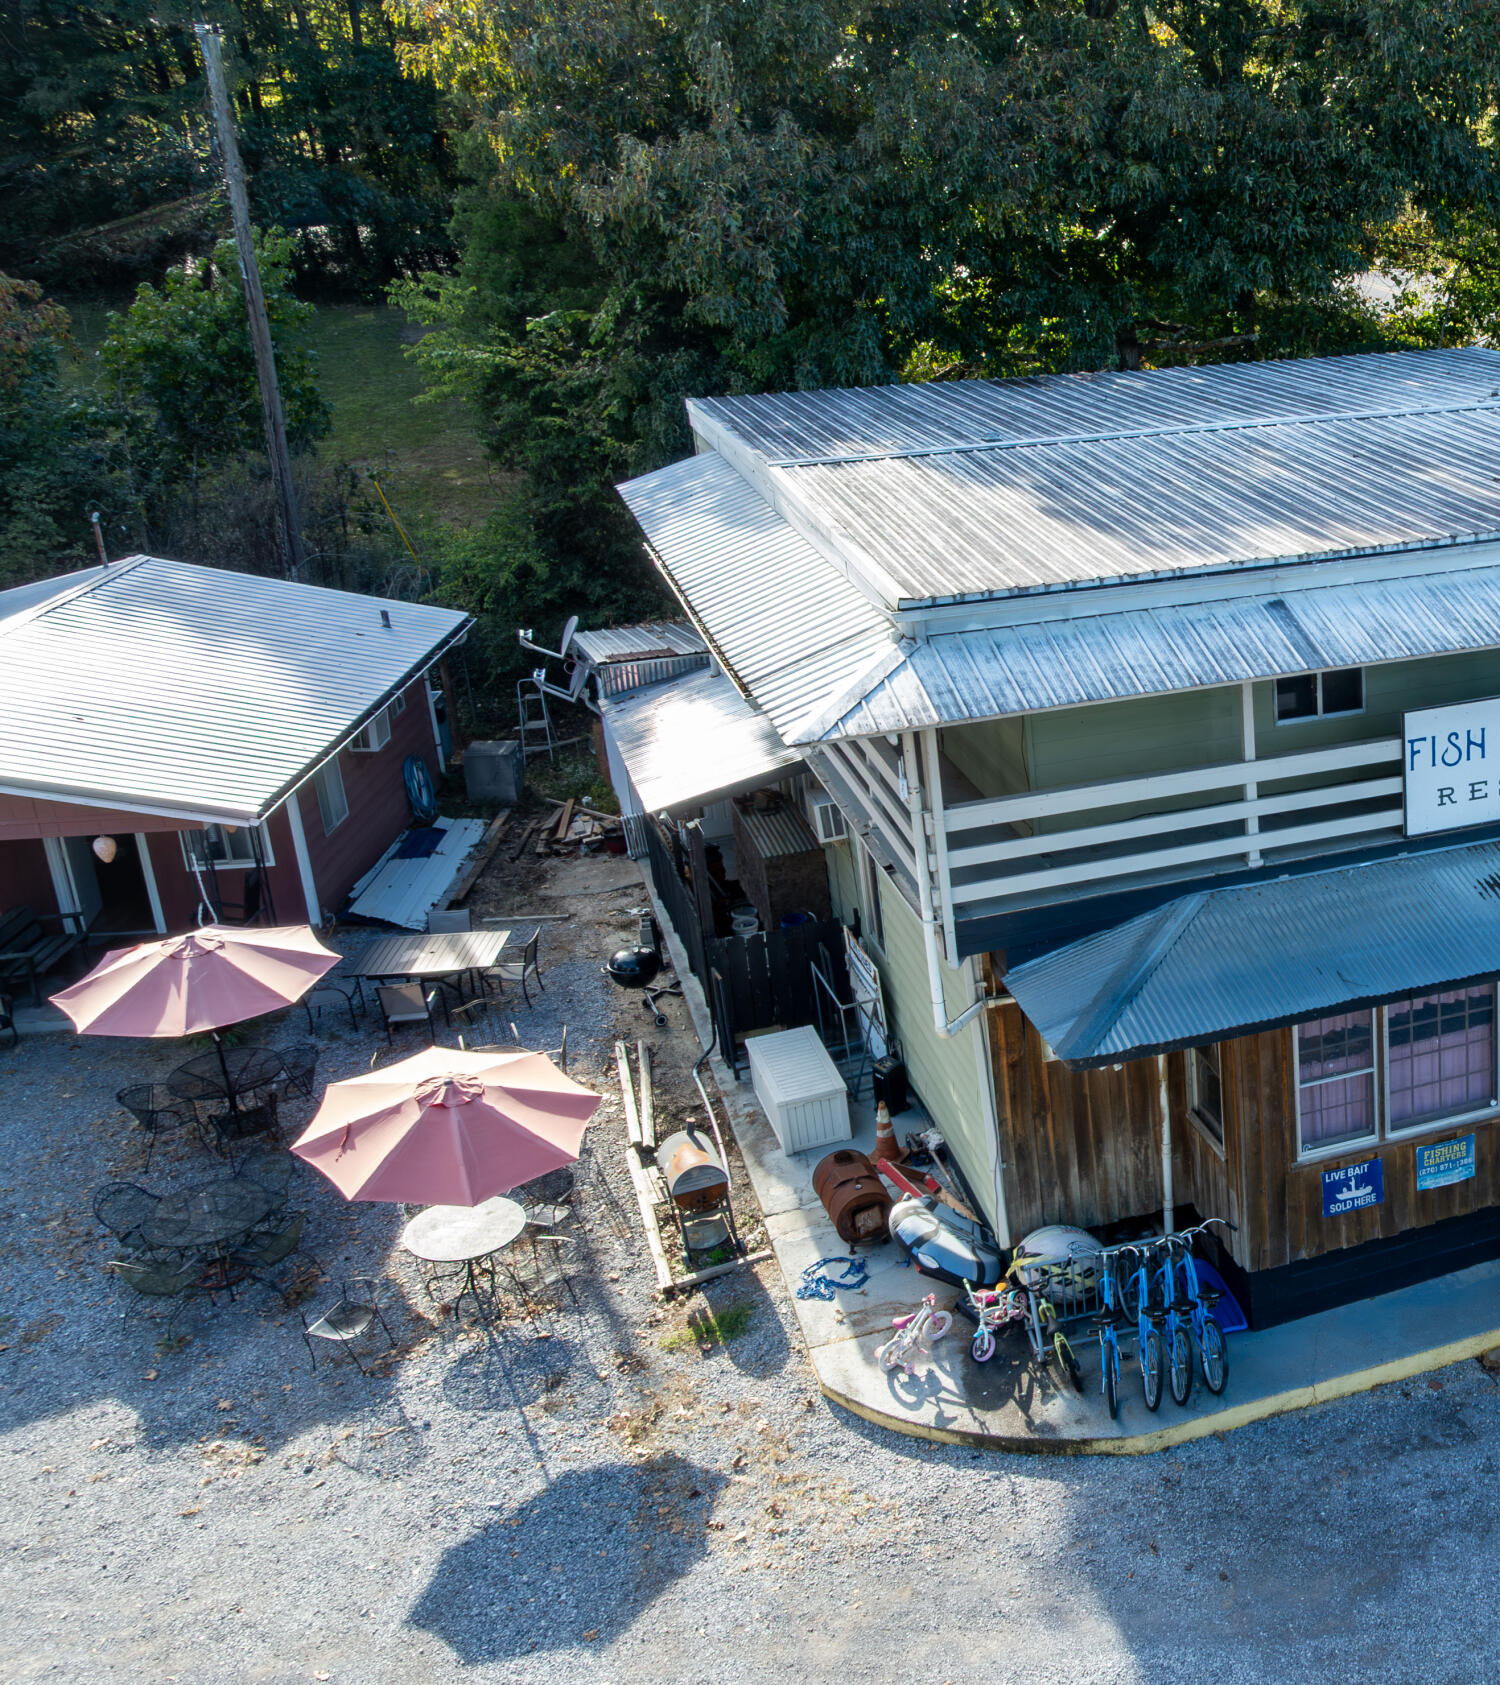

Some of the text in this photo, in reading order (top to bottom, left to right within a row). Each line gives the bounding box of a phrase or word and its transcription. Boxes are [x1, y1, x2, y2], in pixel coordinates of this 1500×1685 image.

[1407, 727, 1486, 771] FISH
[1423, 1141, 1467, 1160] FISHING
[1423, 1150, 1467, 1167] CHARTERS
[1325, 1163, 1369, 1183] LIVE BAIT
[1329, 1194, 1376, 1214] SOLD HERE
